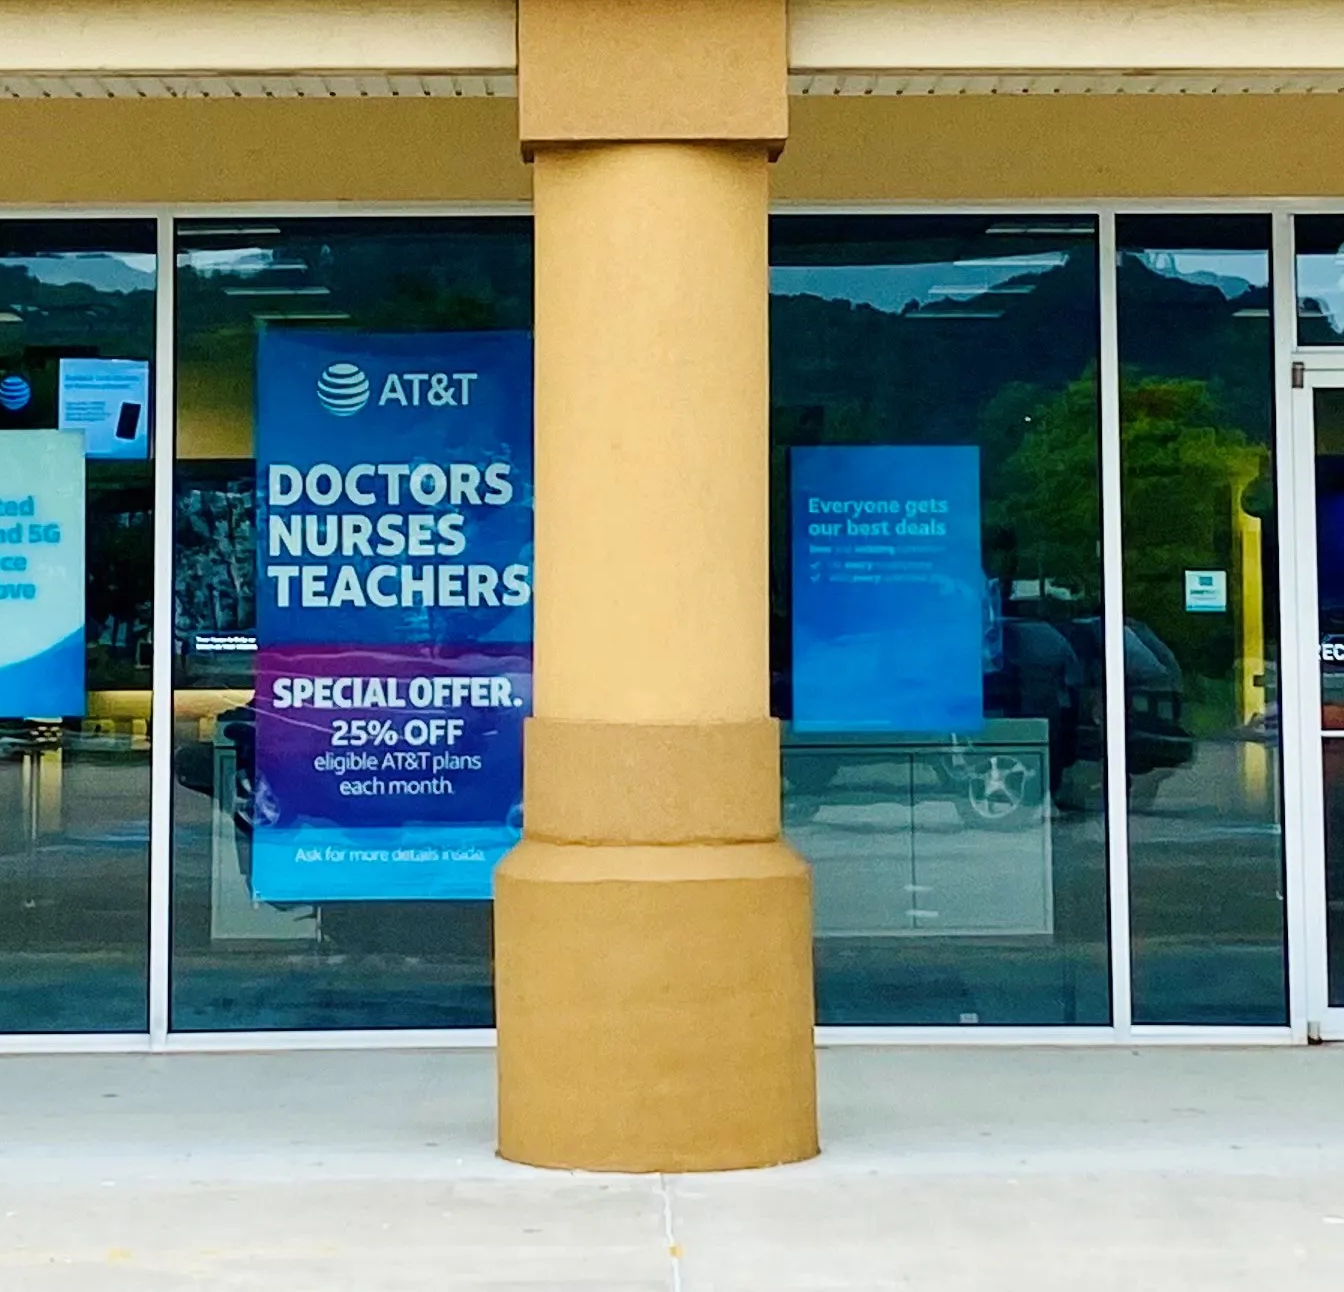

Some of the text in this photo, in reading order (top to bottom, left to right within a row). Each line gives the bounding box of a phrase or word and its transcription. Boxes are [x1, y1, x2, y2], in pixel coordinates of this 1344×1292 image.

[378, 373, 478, 406] AT&T
[268, 463, 514, 506] DOCTORS
[808, 497, 948, 518] Everyone gets
[28, 523, 61, 544] 5G
[268, 513, 467, 557] NURSES
[808, 518, 947, 536] our best deals
[267, 563, 532, 607] TEACHERS
[273, 677, 523, 708] SPECIAL OFFER.
[331, 719, 464, 746] 25% OFF
[314, 751, 482, 775] eligible AT&T plans
[340, 777, 385, 795] each
[295, 847, 323, 862] Ask
[325, 847, 345, 862] for
[349, 849, 388, 862] more
